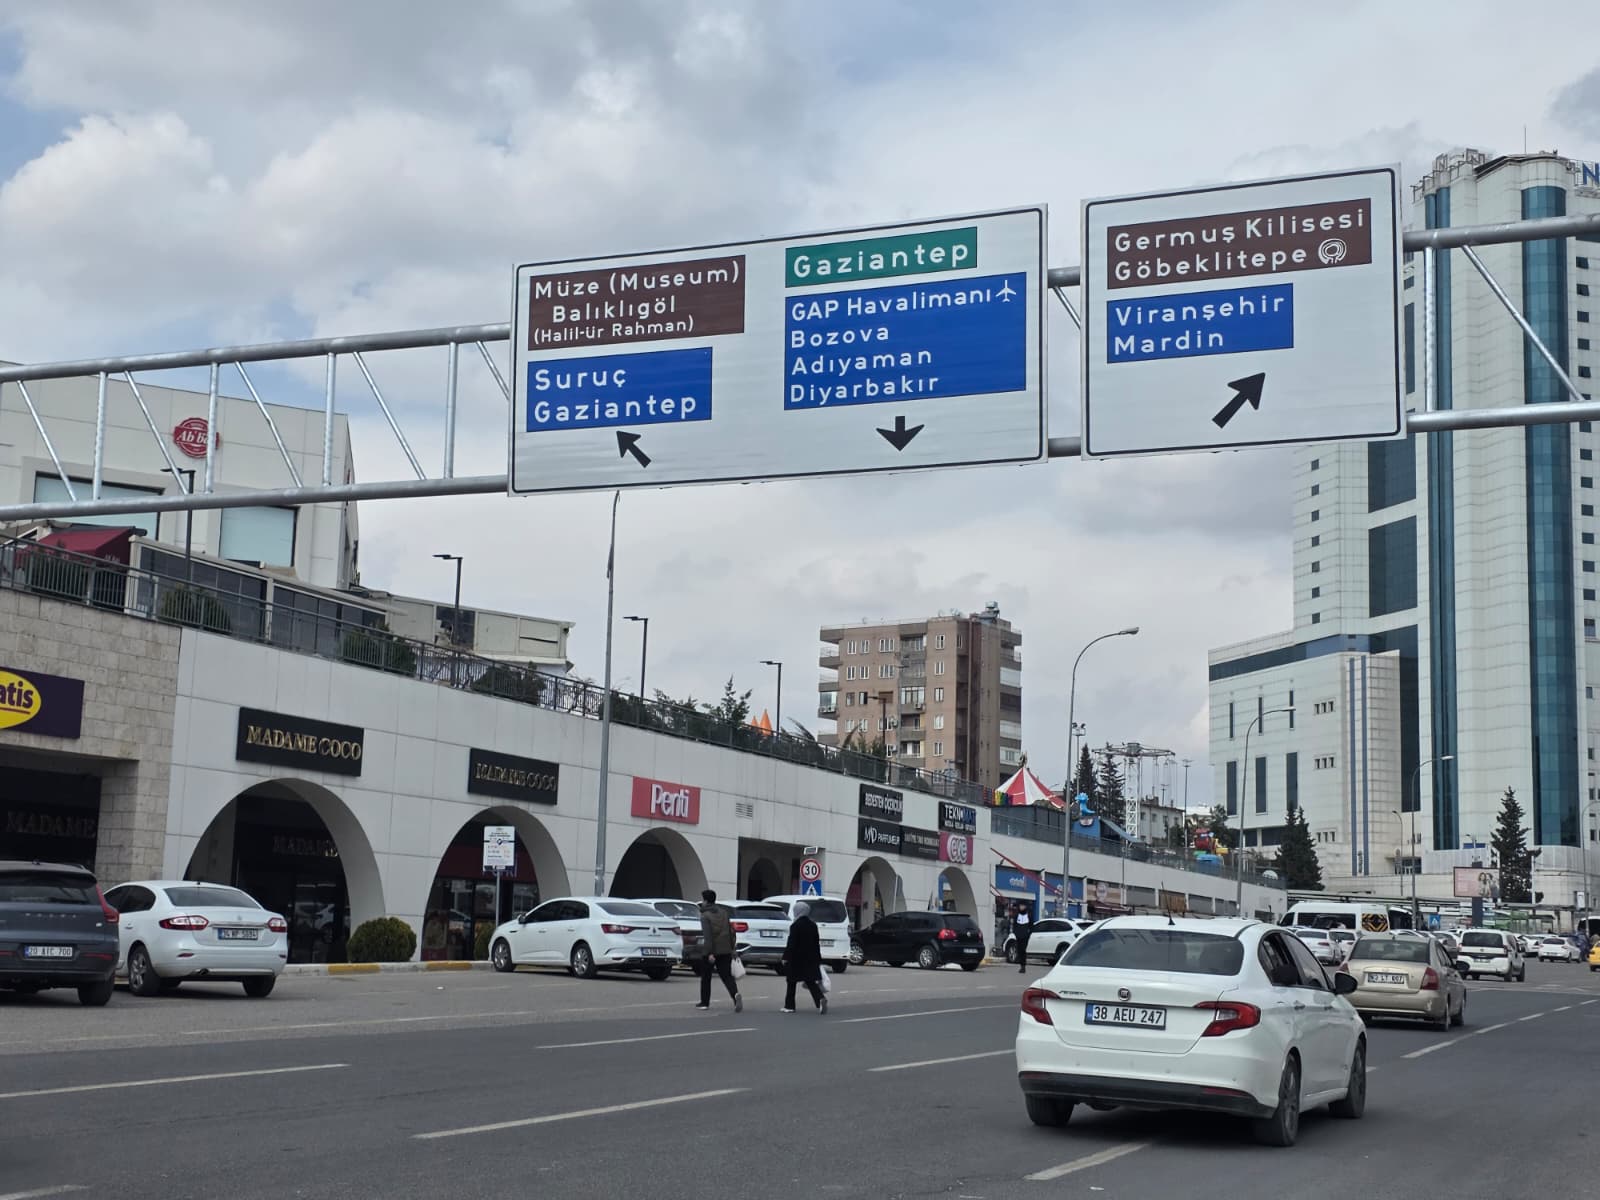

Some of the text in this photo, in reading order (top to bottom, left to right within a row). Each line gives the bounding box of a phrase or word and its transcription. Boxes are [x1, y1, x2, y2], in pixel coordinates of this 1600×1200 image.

[1115, 208, 1364, 252] Germuş Kilisesi
[793, 244, 968, 278] Gaziantep
[1114, 248, 1307, 281] Göbeklitepe
[535, 260, 739, 299] Müze (Museum)
[553, 295, 676, 323] Balıklıgöl
[792, 288, 991, 321] GAP Havalimanı
[1115, 295, 1285, 326] Viranşehir
[534, 315, 694, 345] (Halil-ür Rahman)
[791, 326, 889, 349] Bozova
[1114, 330, 1224, 355] Mardin
[792, 349, 932, 376] Adıyaman
[535, 369, 627, 391] Suruç
[791, 375, 939, 405] Diyarbakır
[534, 395, 696, 423] Gaziantep
[246, 725, 362, 761] MADAME COCO
[650, 784, 690, 818] Penti
[804, 864, 818, 877] 30
[1094, 1007, 1162, 1024] 38 AEU 247
